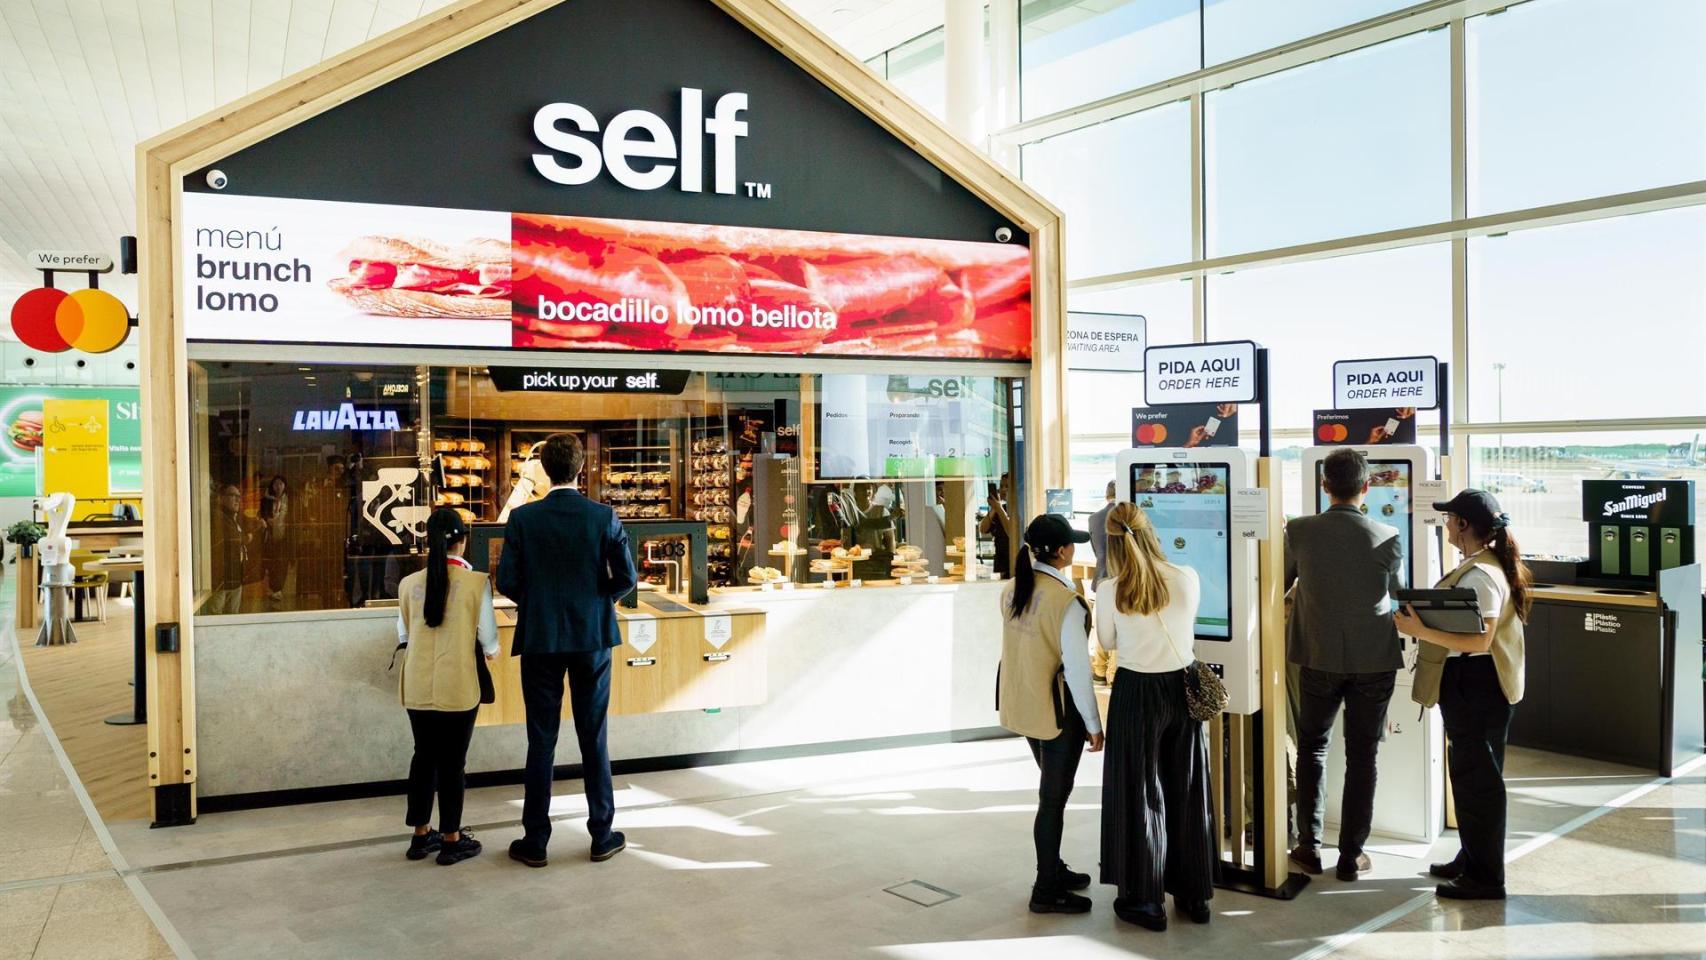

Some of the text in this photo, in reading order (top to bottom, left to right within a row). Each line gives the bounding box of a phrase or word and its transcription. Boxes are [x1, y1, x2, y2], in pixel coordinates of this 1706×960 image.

[532, 87, 748, 195] self
[197, 226, 281, 250] menú
[38, 253, 100, 265] We prefer
[197, 253, 311, 282] brunch
[197, 285, 278, 312] lomo
[538, 295, 837, 329] bocadillo lomo bellota
[1090, 331, 1103, 341] DE
[1104, 332, 1139, 342] ESPERA
[1098, 344, 1120, 352] AREA
[1159, 358, 1240, 374] PIDA AQUI
[523, 371, 558, 389] pick
[559, 376, 580, 388] up
[582, 376, 618, 390] your
[1159, 376, 1240, 390] ORDER HERE
[1346, 370, 1424, 386] PIDA AQUI
[1347, 386, 1423, 399] ORDER HERE
[292, 402, 401, 431] LAVAZZA
[1148, 412, 1168, 420] prefer
